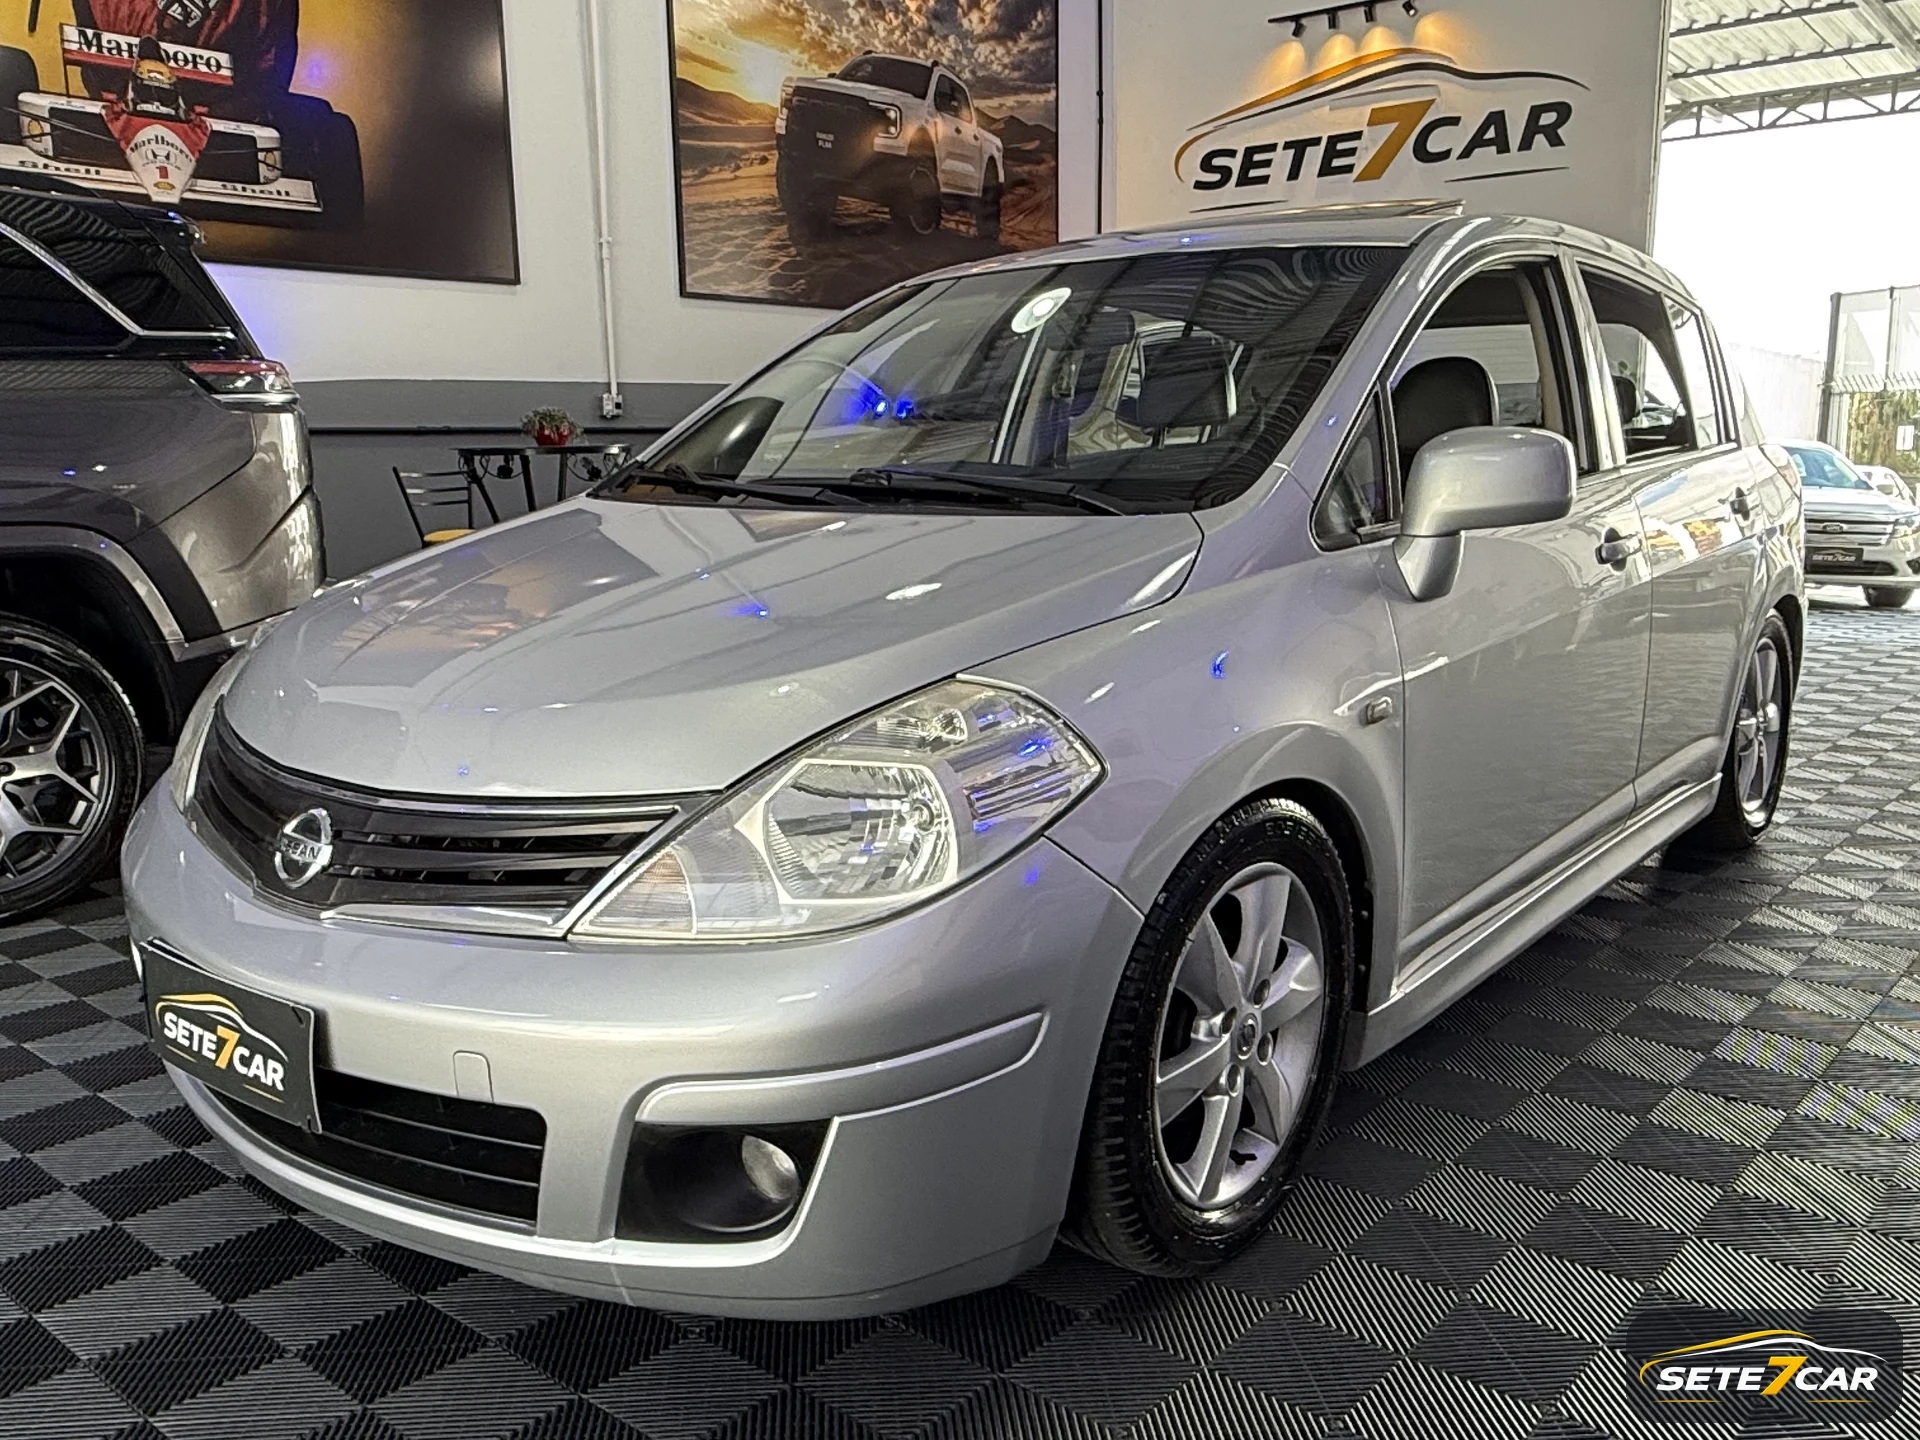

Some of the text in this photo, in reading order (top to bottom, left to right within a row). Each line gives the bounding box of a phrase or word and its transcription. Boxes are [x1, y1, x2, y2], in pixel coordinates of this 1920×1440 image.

[77, 27, 222, 73] Maroro
[1193, 98, 1573, 191] SETE7CAR
[164, 1011, 285, 1091] SETE7CAR
